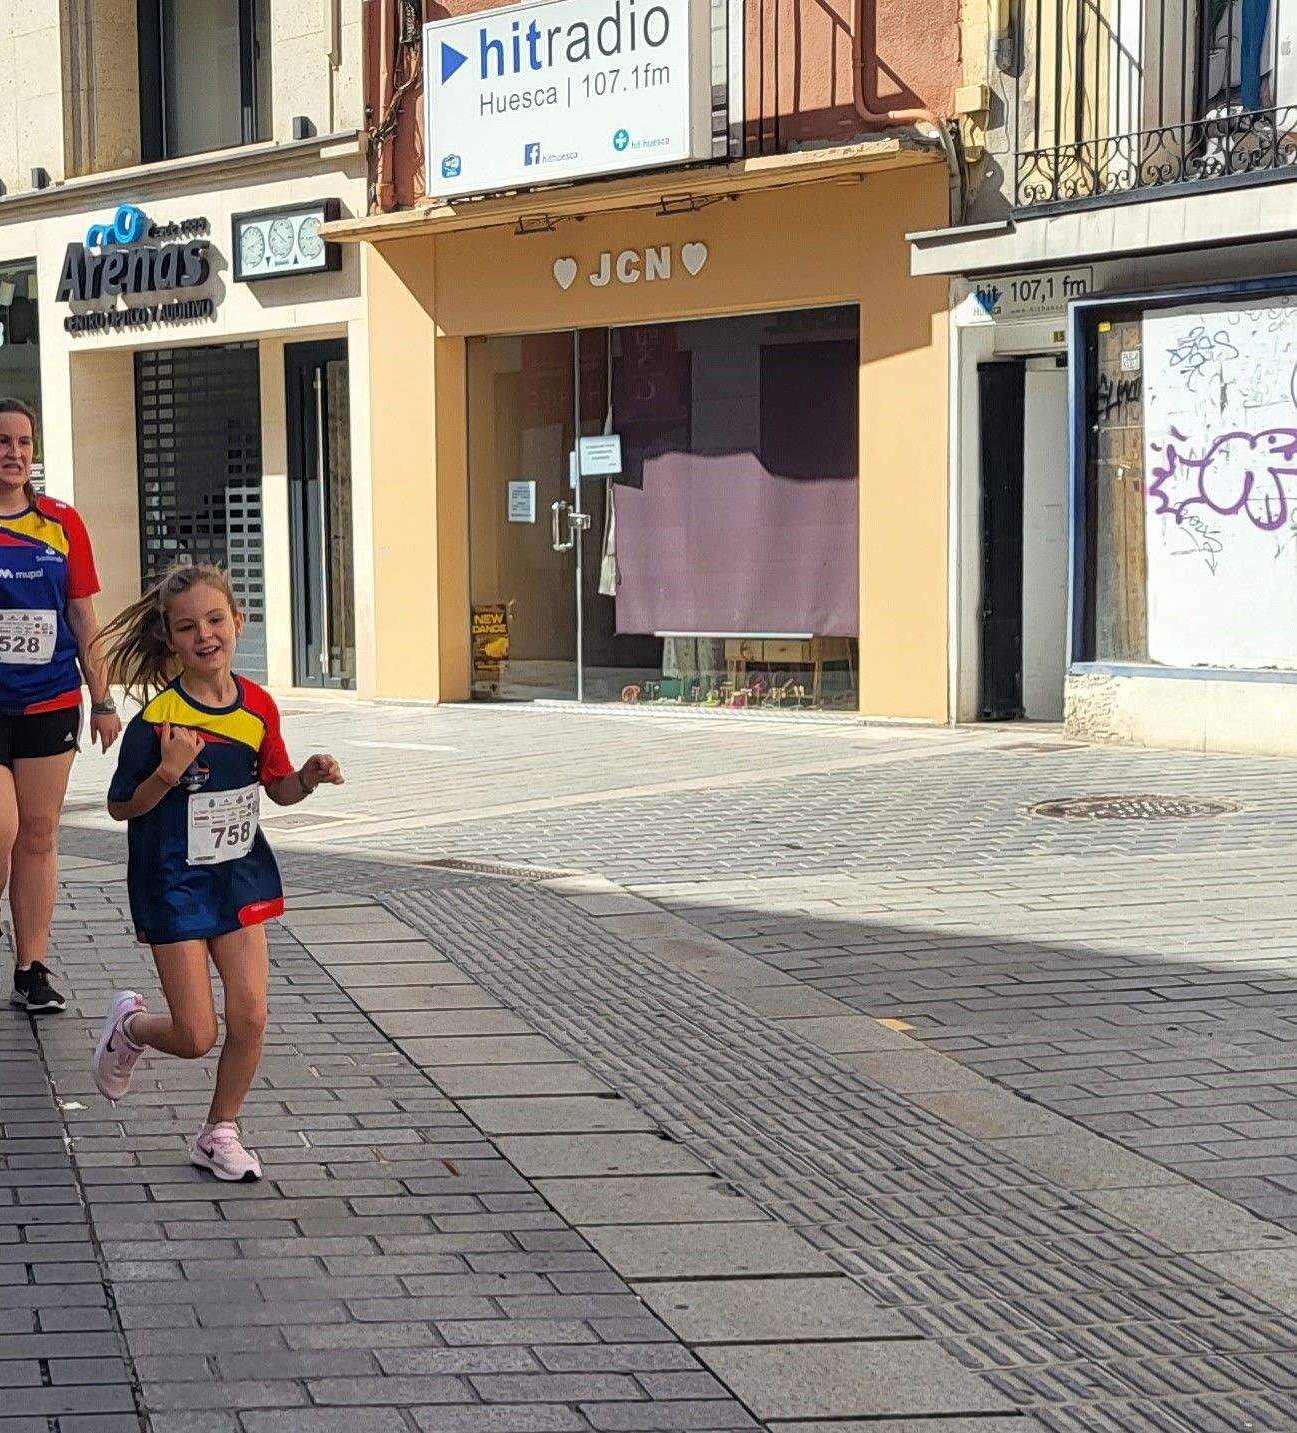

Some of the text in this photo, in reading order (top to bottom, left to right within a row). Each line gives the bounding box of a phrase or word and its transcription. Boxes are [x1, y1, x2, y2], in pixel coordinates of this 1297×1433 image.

[479, 0, 670, 80] hitradio
[480, 86, 557, 116] Huesca
[582, 63, 670, 98] 107.1fm
[55, 239, 211, 302] Arenas
[590, 246, 671, 286] JCN
[1011, 277, 1054, 303] 107,1
[1063, 275, 1087, 297] fm
[472, 625, 506, 633] DANCE
[474, 613, 503, 624] NEW
[210, 821, 250, 849] 758
